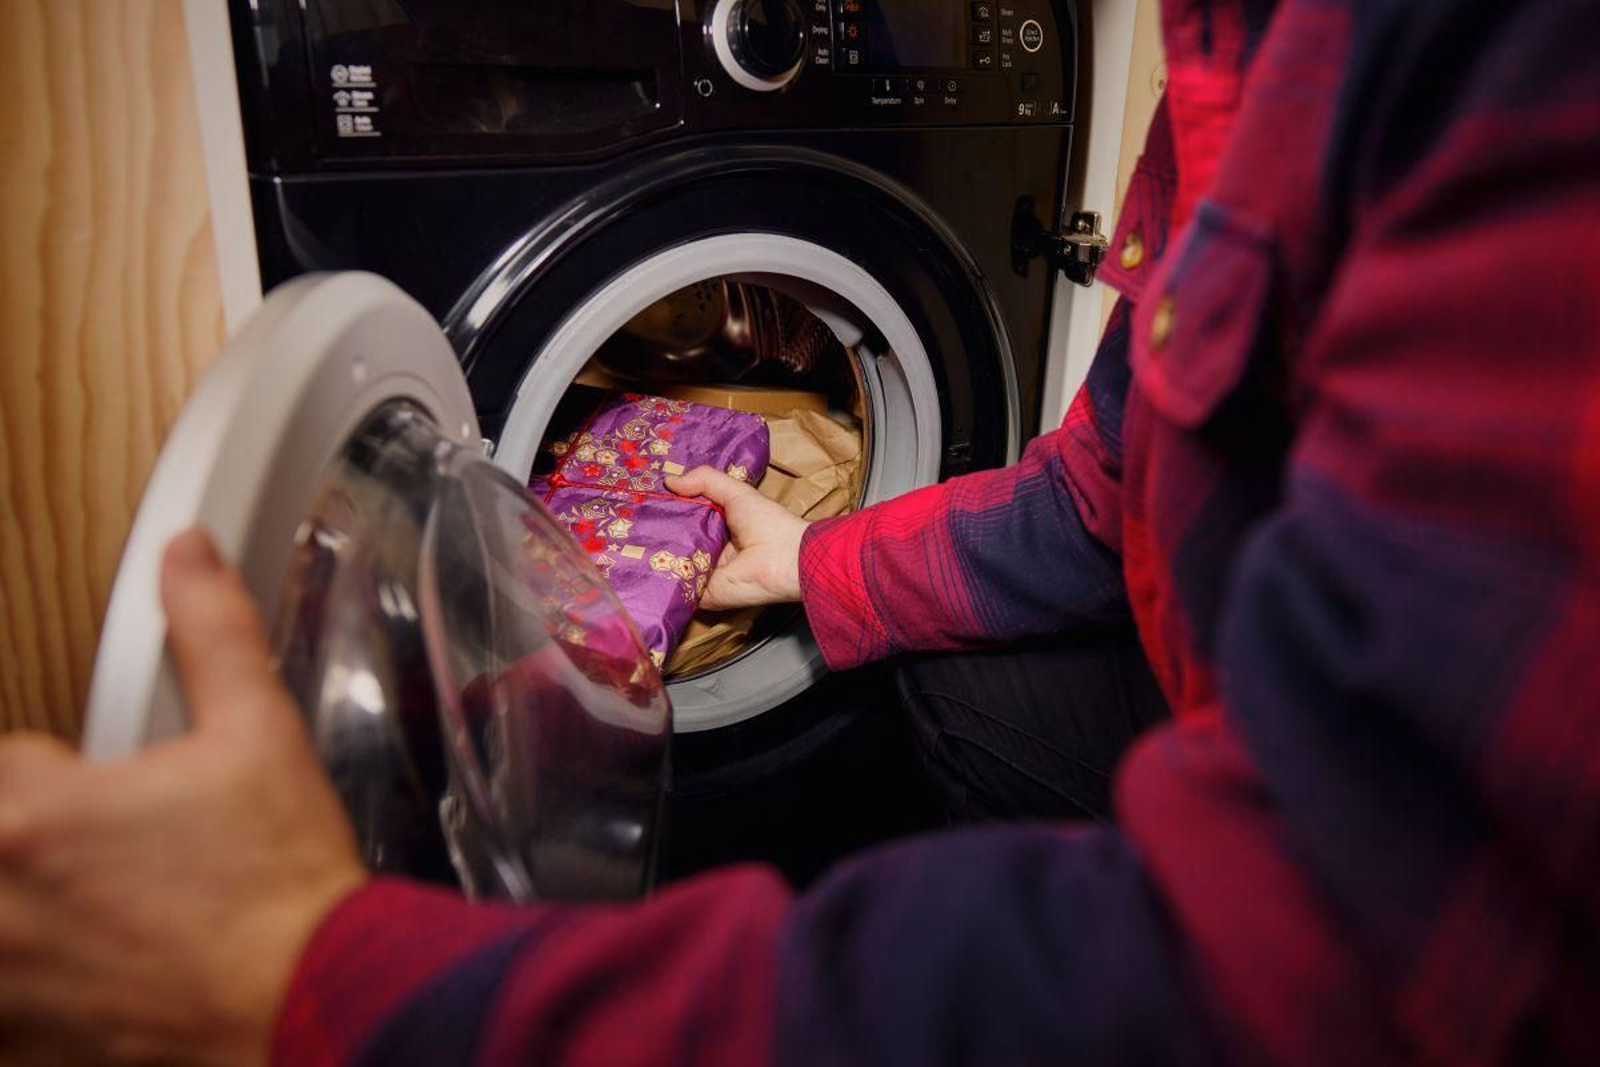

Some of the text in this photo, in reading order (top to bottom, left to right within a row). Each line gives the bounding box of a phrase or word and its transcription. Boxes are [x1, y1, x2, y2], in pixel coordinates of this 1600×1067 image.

[812, 25, 829, 35] Drying
[815, 56, 829, 65] Clean
[871, 96, 901, 105] Temperature
[1018, 103, 1025, 116] 9
